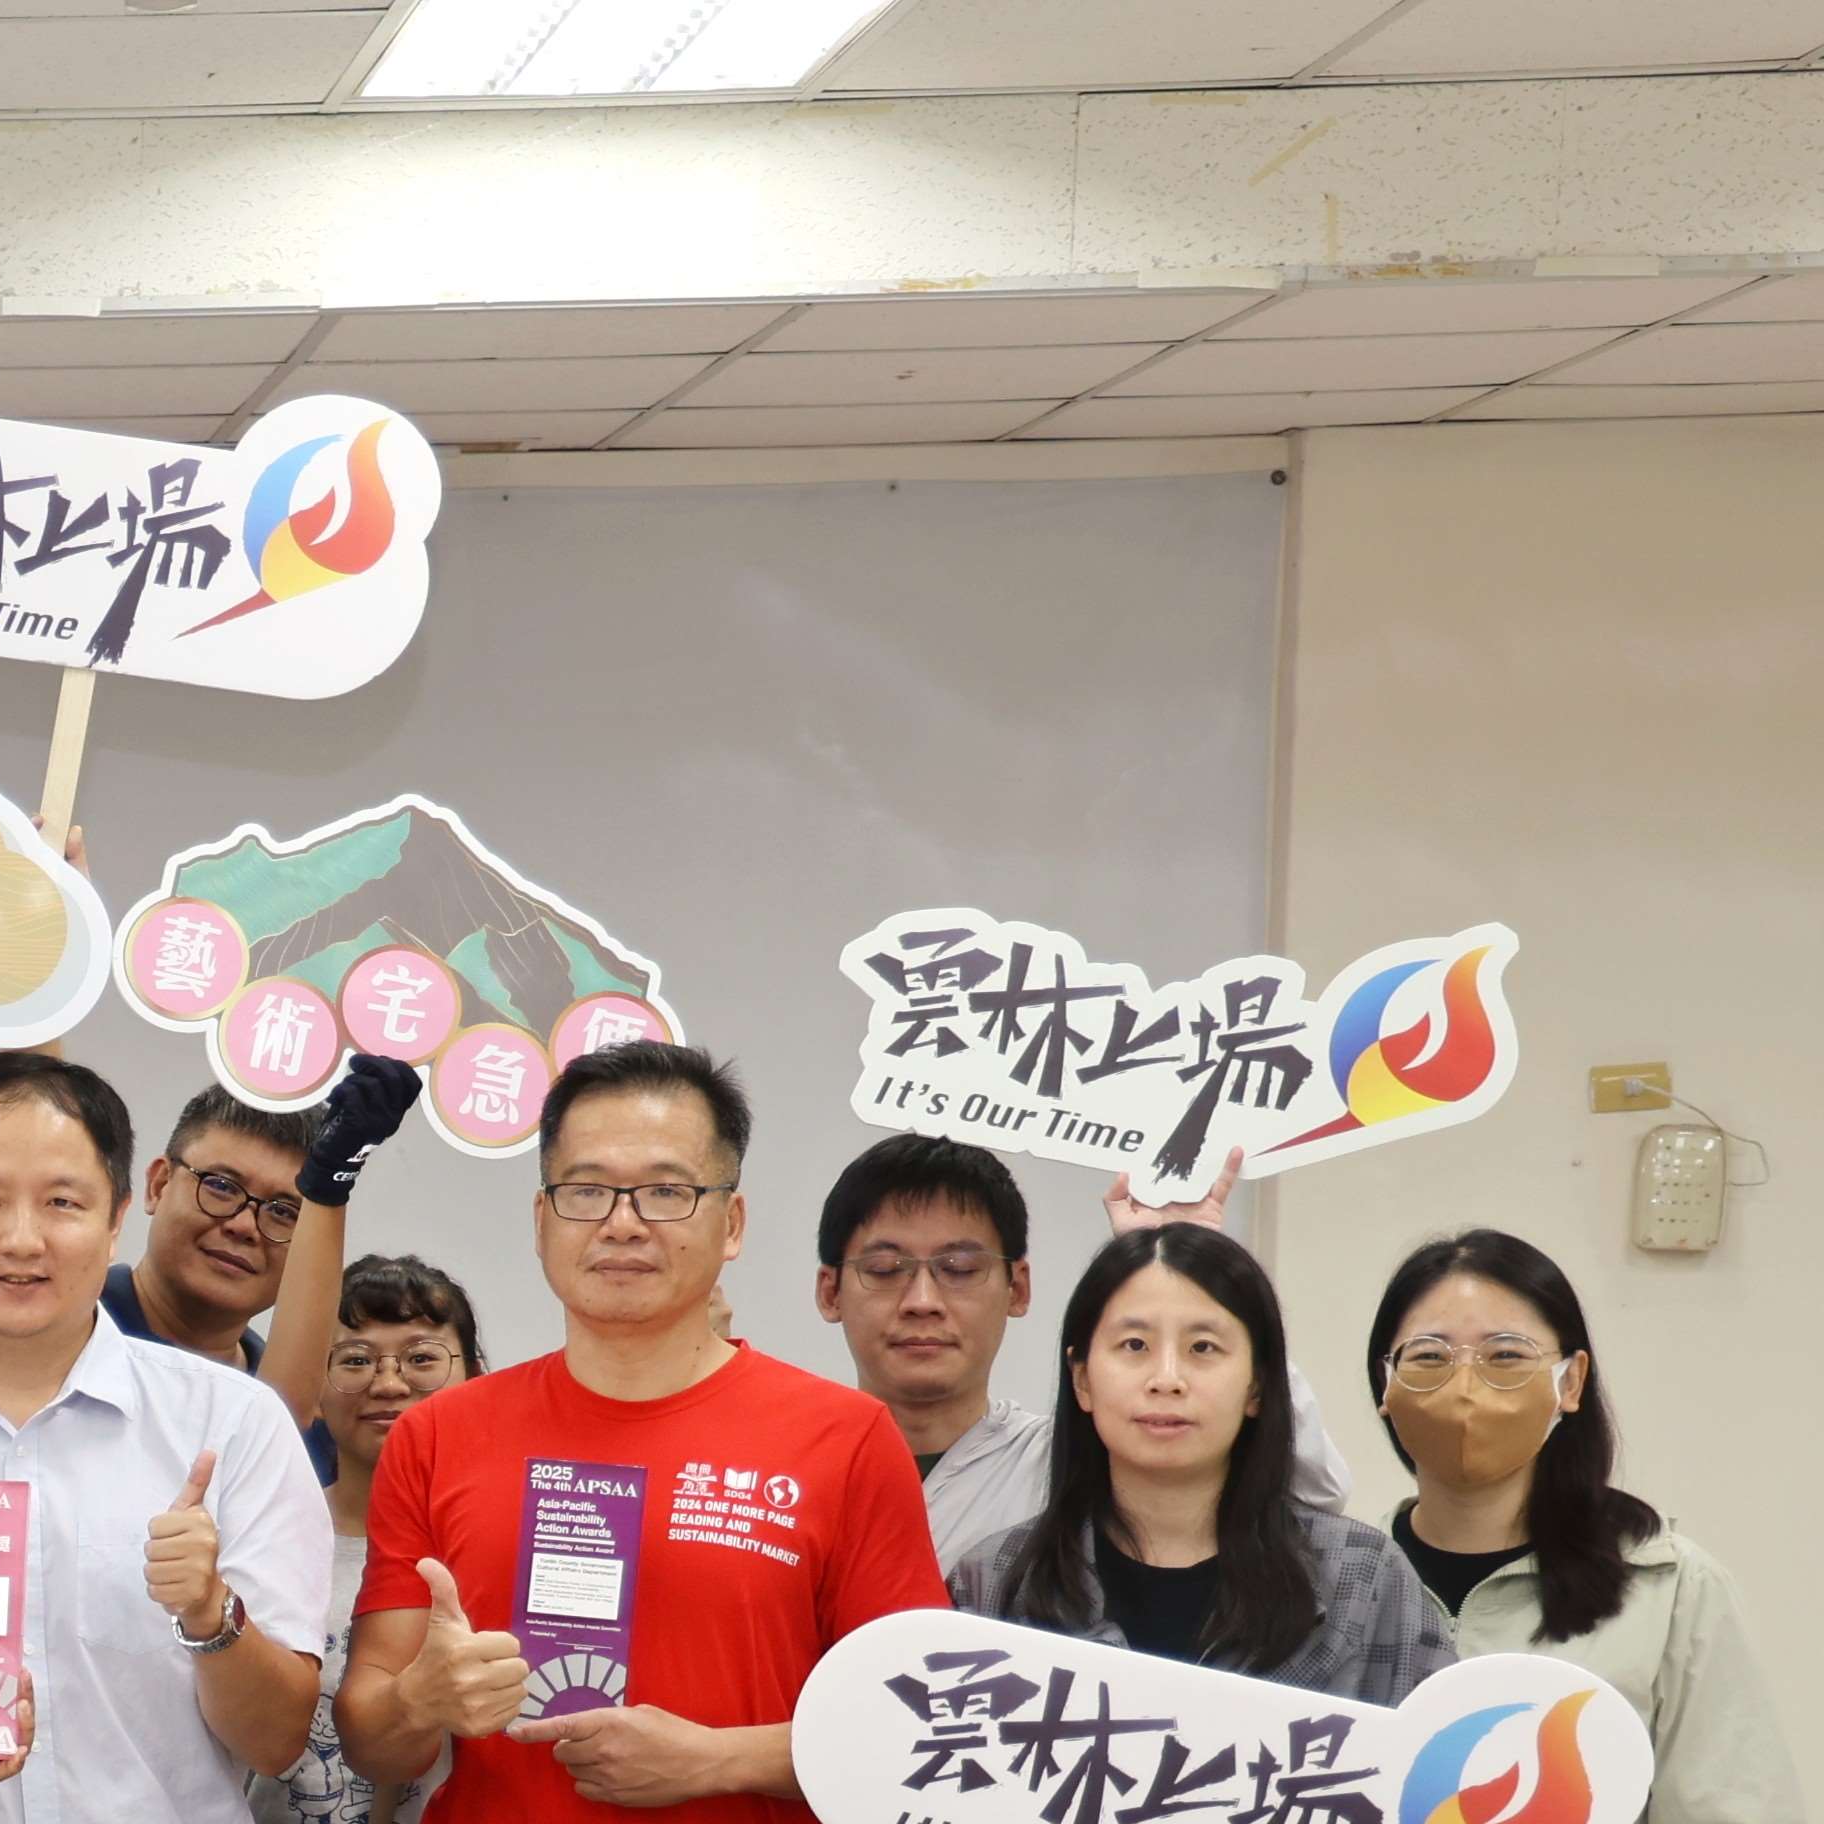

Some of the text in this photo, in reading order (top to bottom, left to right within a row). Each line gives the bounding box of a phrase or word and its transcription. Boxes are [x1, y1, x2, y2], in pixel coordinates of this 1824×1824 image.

[864, 928, 1312, 1185] 雲林上場
[874, 1076, 1146, 1153] It's Our Time
[531, 1464, 573, 1480] 2025
[531, 1480, 638, 1497] The 4th APSAA
[724, 1489, 751, 1500] SDG4
[538, 1498, 596, 1512] Asia-Pacific
[673, 1498, 796, 1529] 2024 ONE MORE PAGE
[537, 1510, 606, 1526] Sustainability
[671, 1513, 751, 1533] READING AND
[535, 1522, 612, 1538] Action Awards
[668, 1529, 799, 1567] SUSTAINABILITY MARKET
